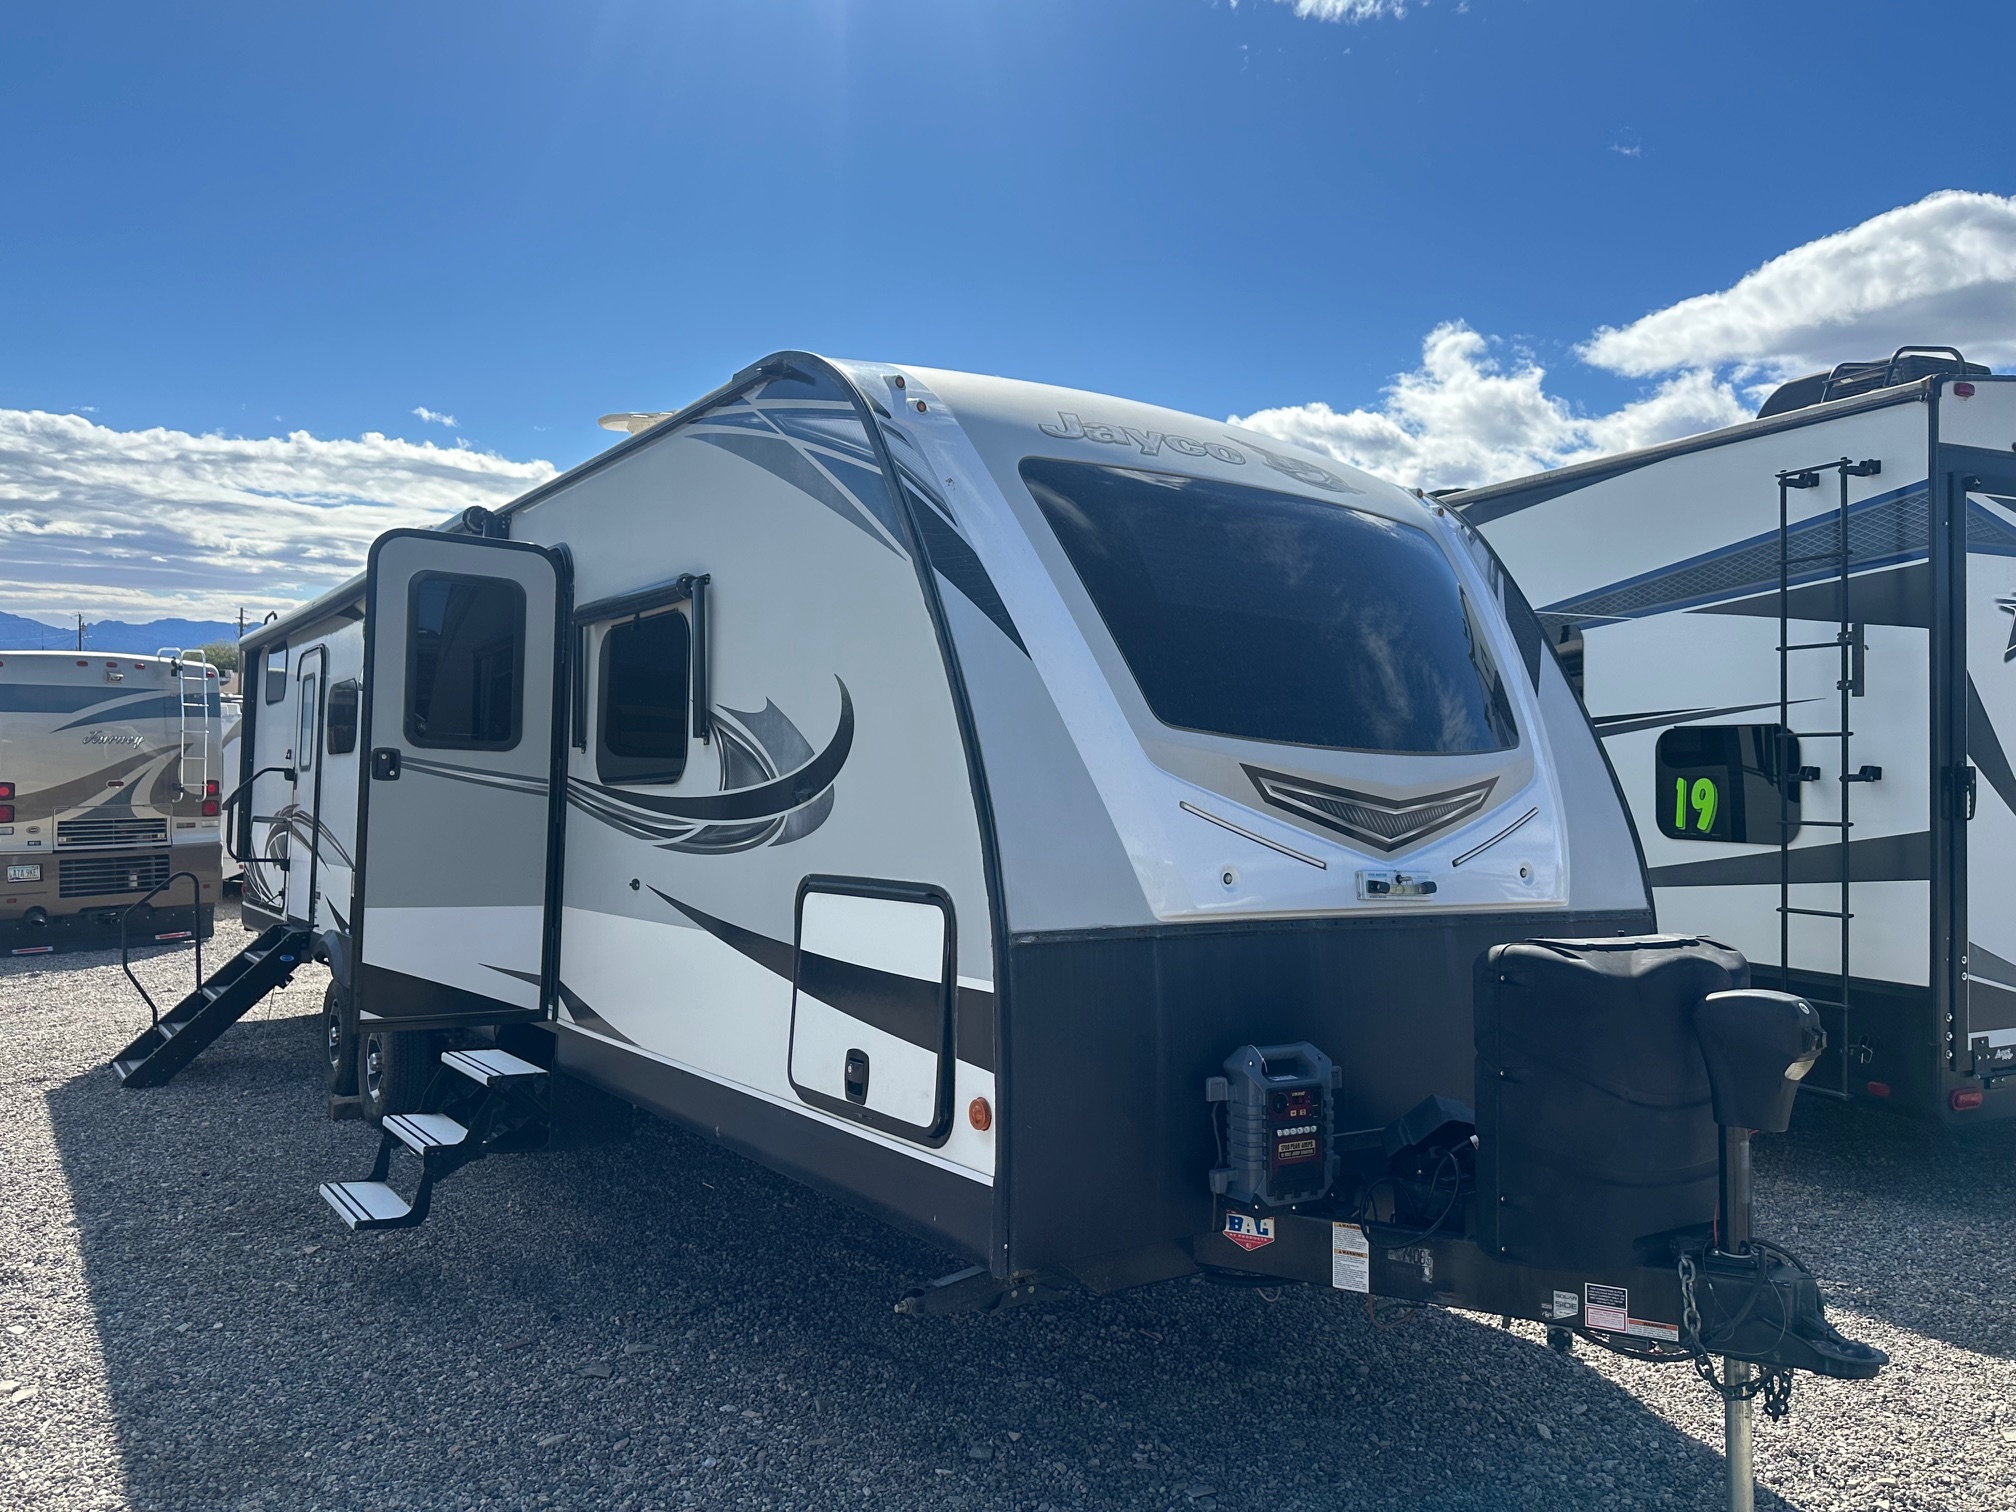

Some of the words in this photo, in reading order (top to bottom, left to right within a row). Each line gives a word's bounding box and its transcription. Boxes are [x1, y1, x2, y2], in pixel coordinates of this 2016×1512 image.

[1038, 411, 1246, 466] Jayco
[83, 730, 144, 750] Journey
[1675, 777, 1718, 833] 19
[1555, 1301, 1577, 1309] SIDE
